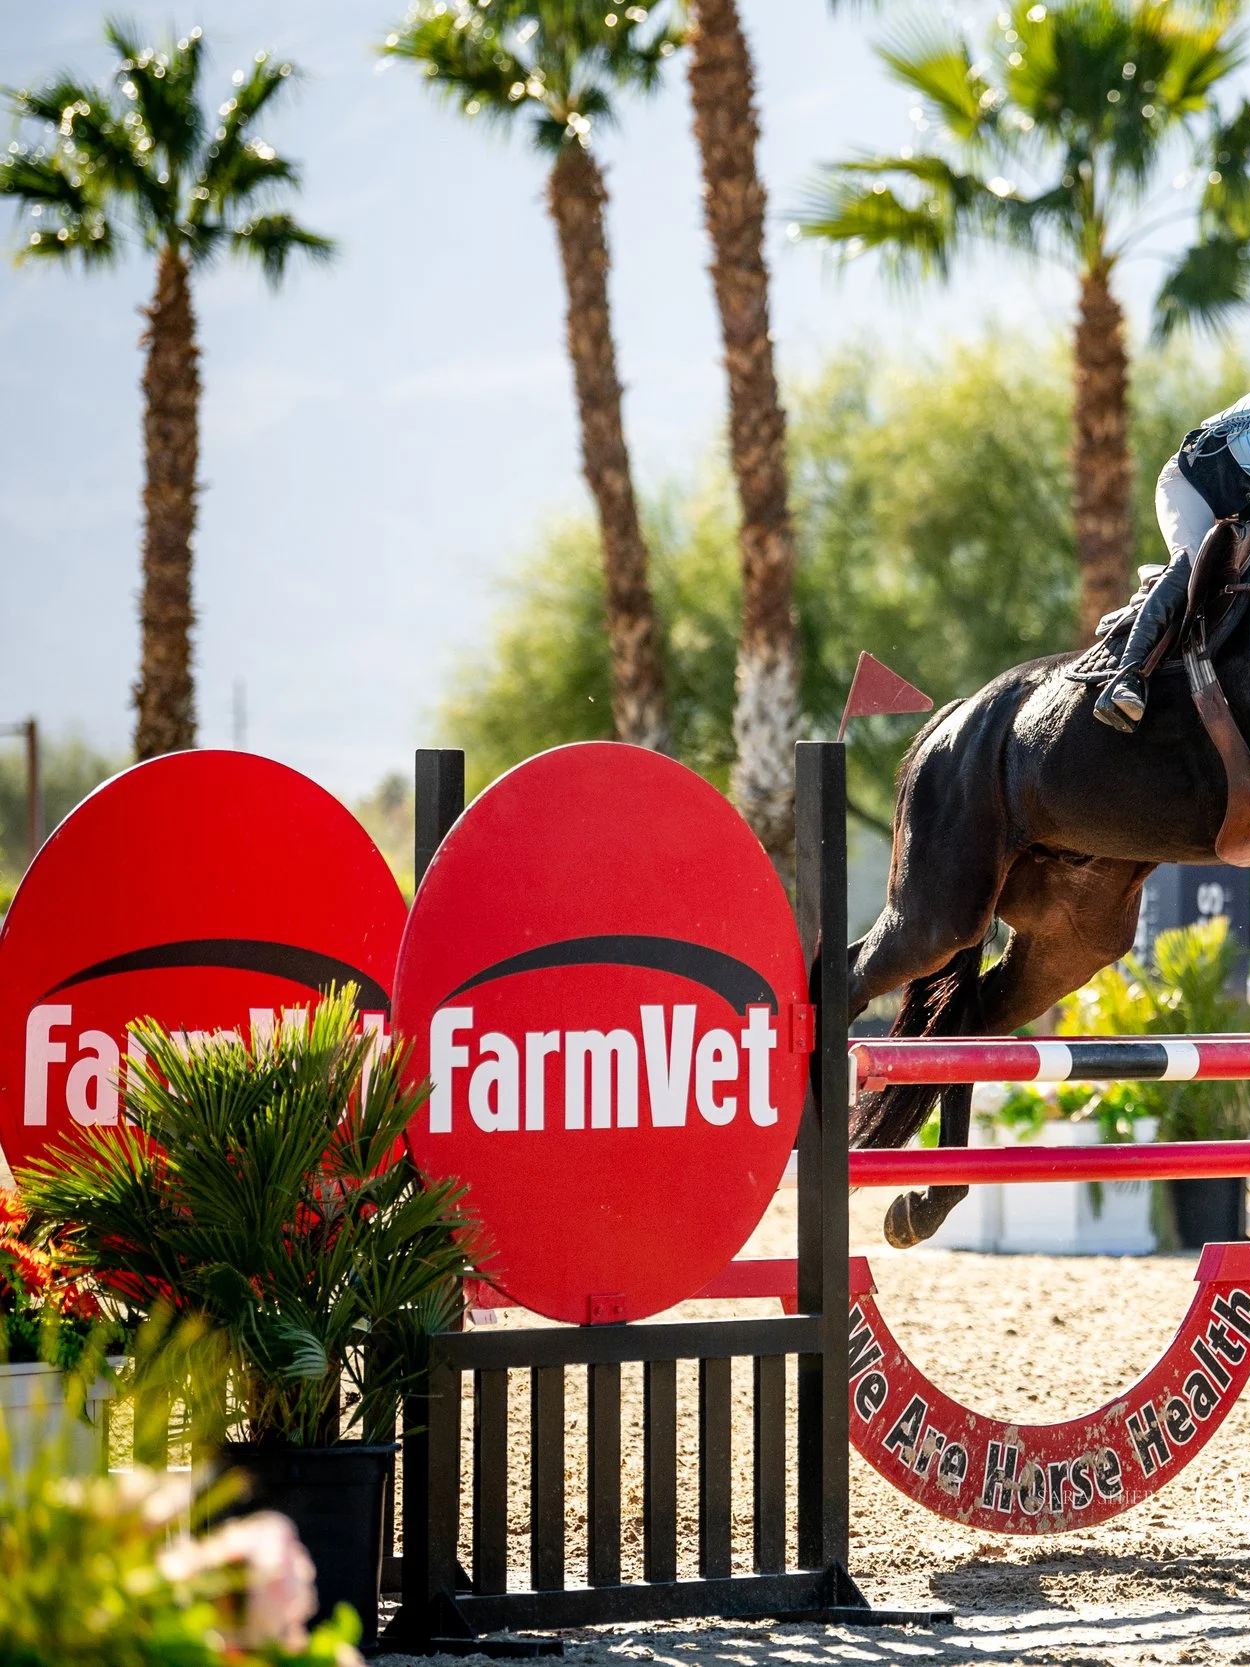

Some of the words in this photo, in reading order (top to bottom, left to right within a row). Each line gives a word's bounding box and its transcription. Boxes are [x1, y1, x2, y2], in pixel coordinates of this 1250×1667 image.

[24, 1004, 392, 1128] Fart
[429, 1004, 778, 1133] FarmVet
[848, 1303, 888, 1424] We
[881, 1392, 969, 1497] Are
[981, 1440, 1124, 1517] Horse
